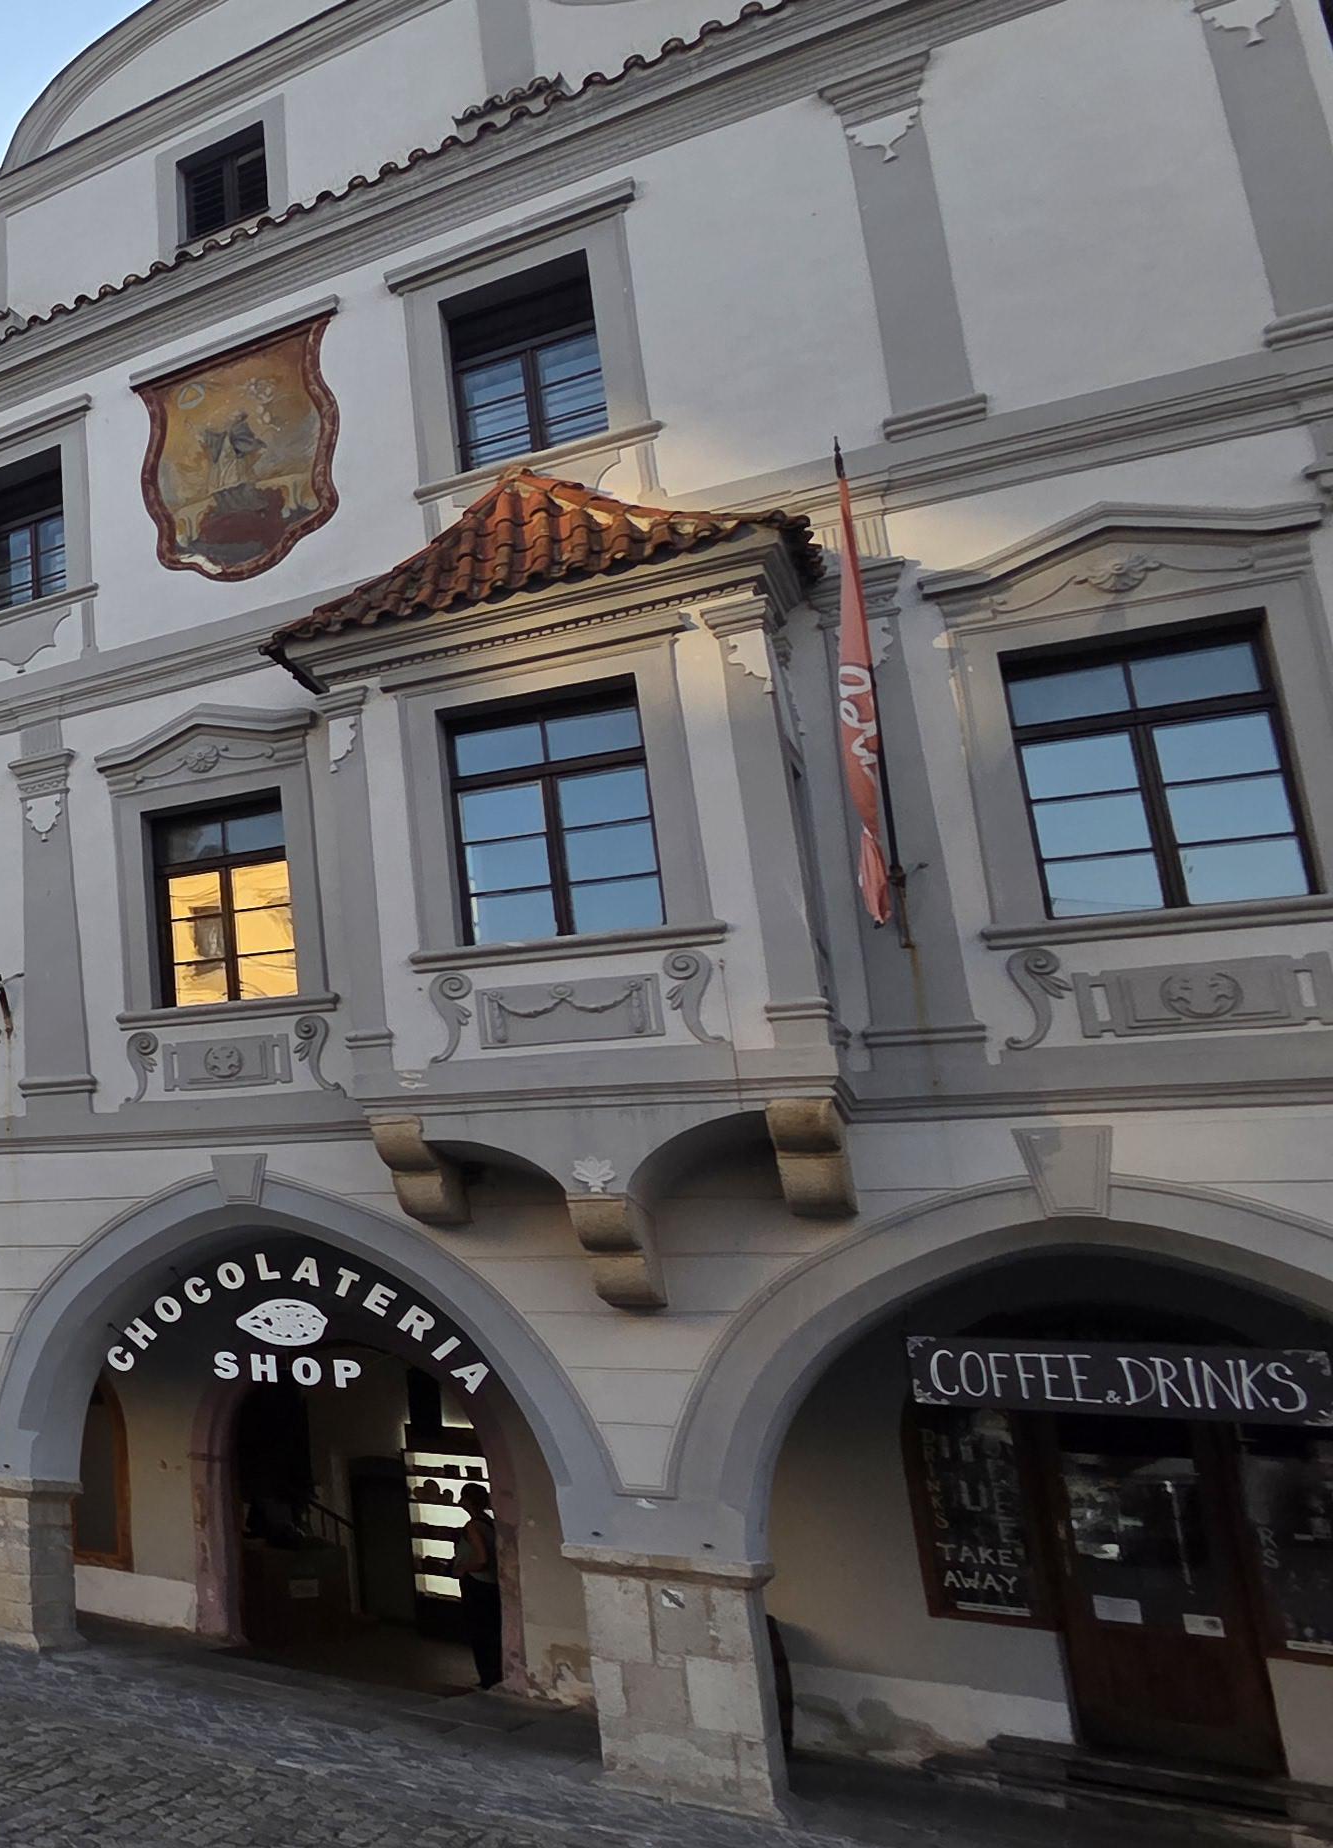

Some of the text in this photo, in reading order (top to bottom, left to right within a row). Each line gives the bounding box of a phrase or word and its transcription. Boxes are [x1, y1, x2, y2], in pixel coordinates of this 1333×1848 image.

[106, 1252, 495, 1395] CHOCOLATERIA
[212, 1350, 364, 1389] SHOP
[928, 1348, 1104, 1405] COFFEE
[1116, 1355, 1309, 1414] DRINKS
[934, 1540, 1019, 1568] TAKE
[942, 1568, 1020, 1594] AWAY
